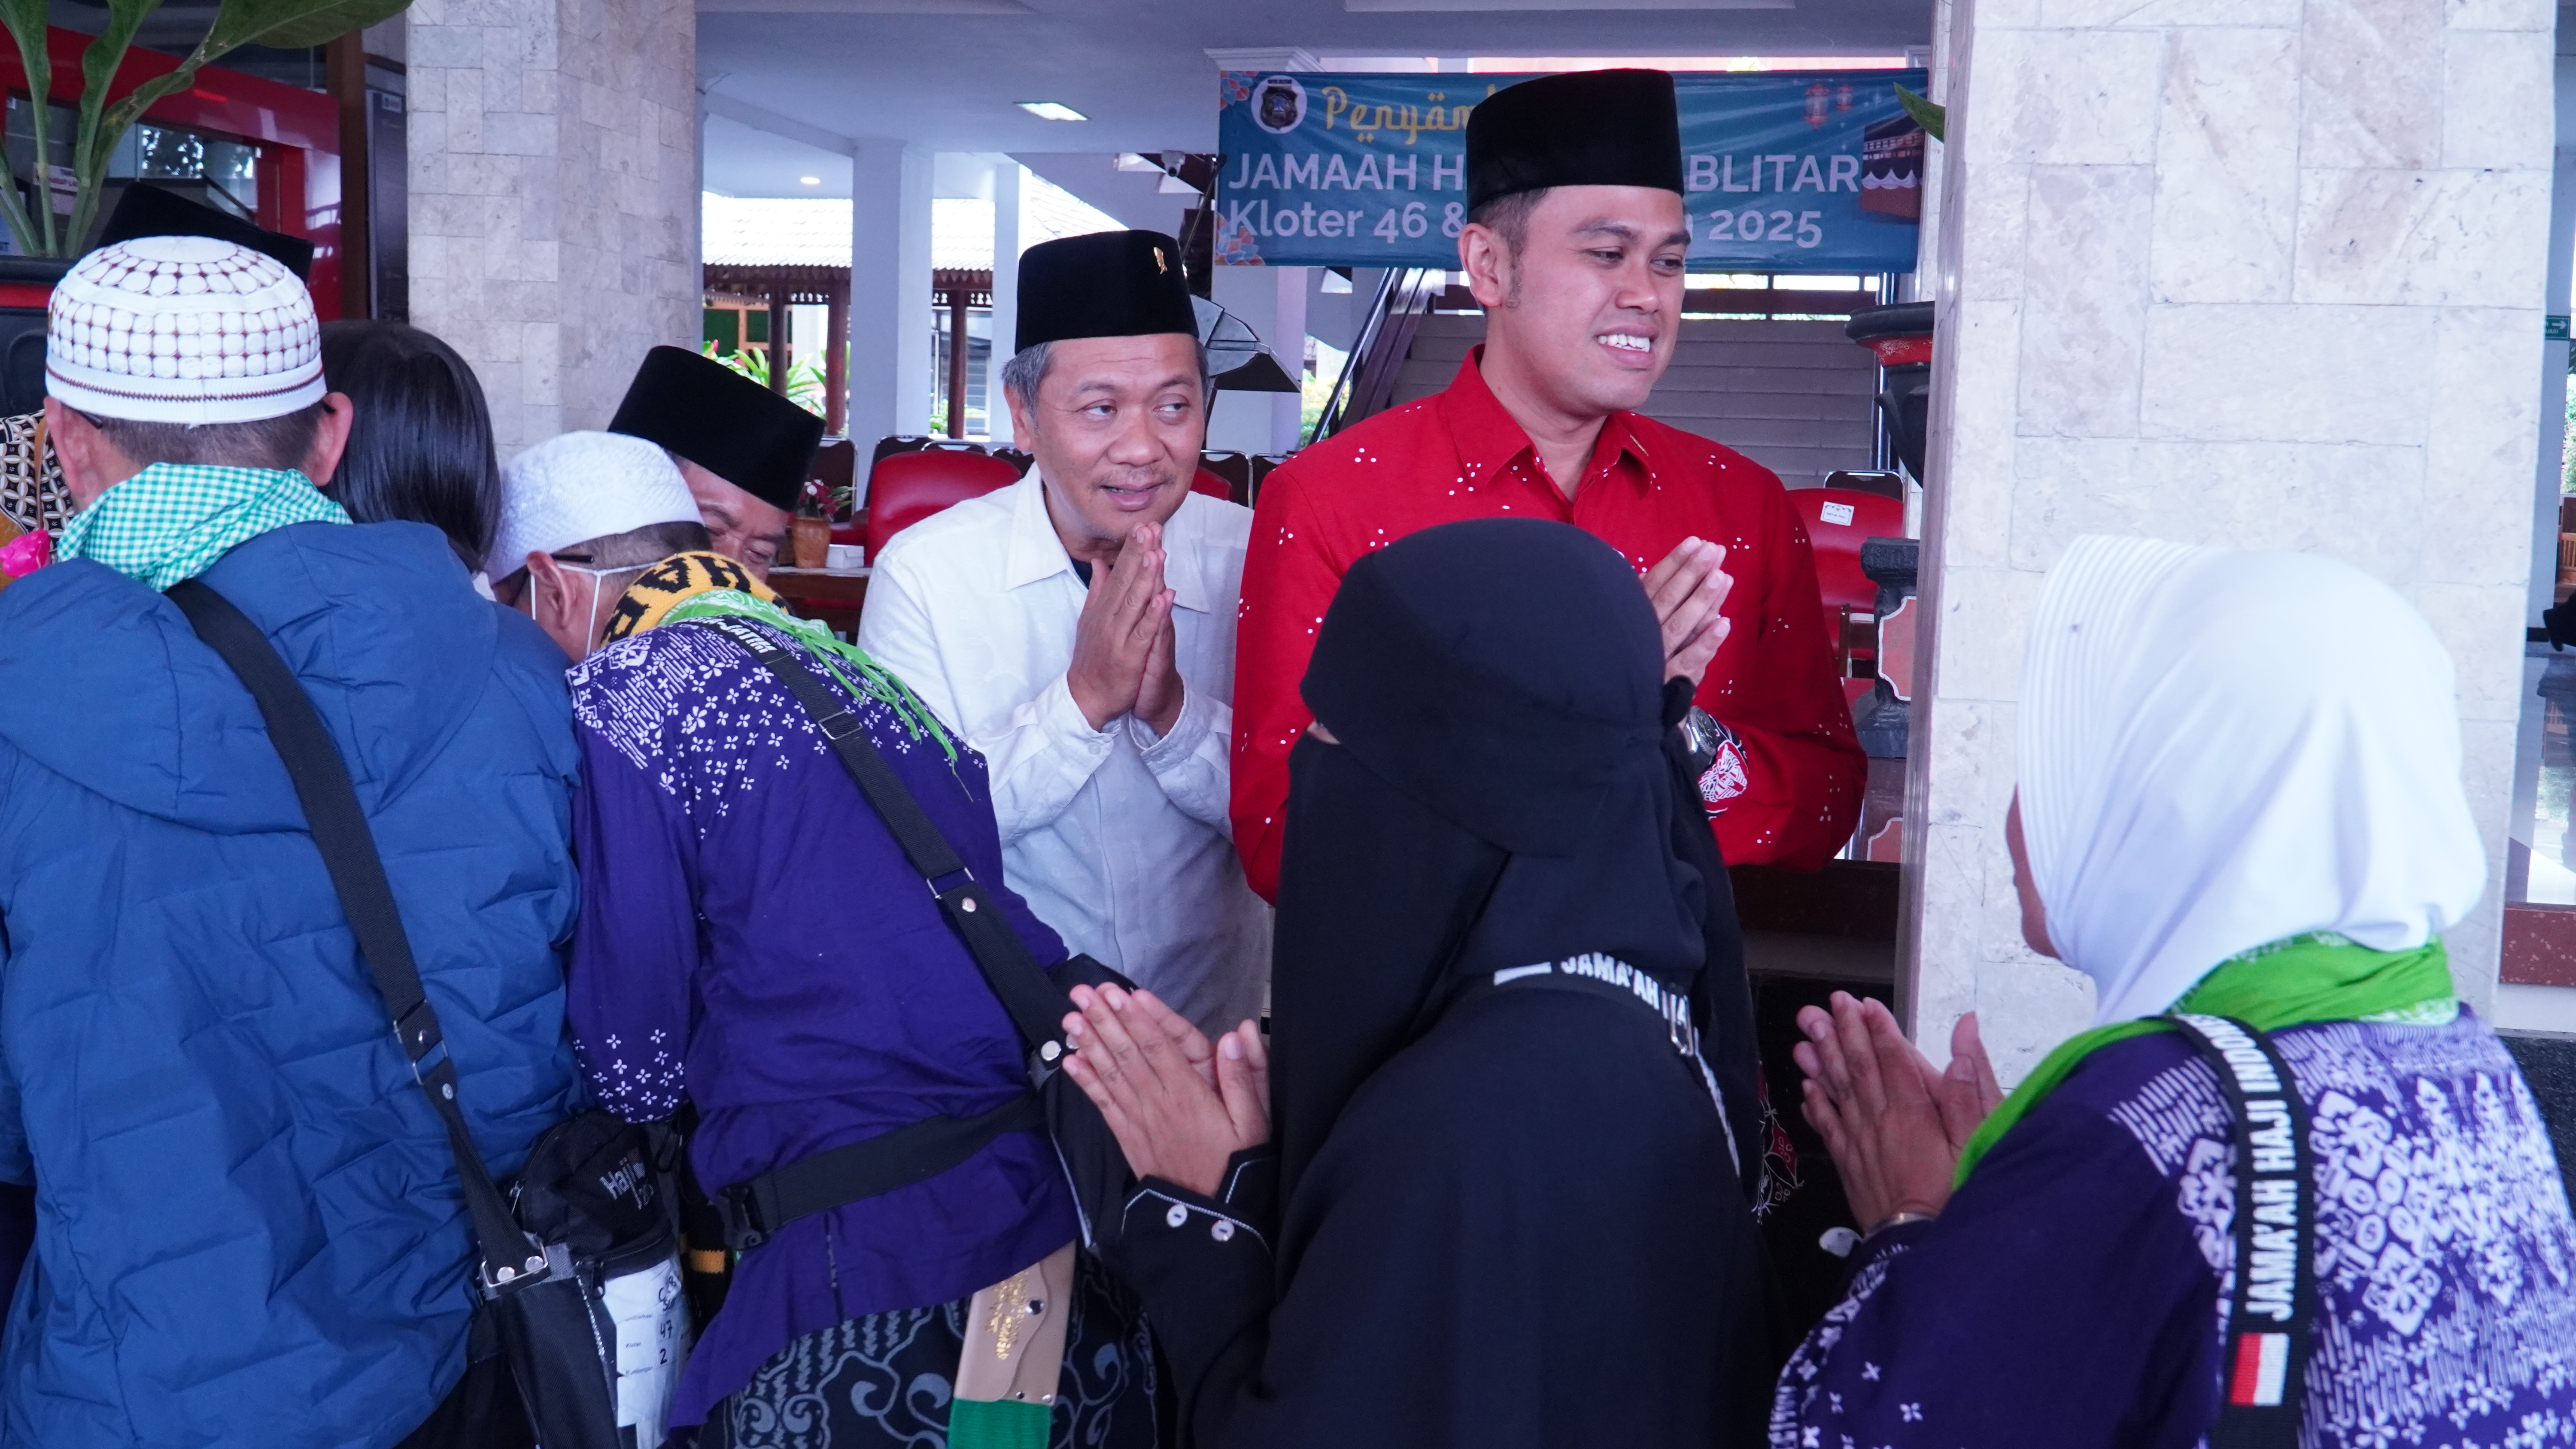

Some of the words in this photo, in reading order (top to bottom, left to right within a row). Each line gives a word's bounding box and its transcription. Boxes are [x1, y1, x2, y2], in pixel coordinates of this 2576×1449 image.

[1228, 153, 1417, 190] JAMAAH
[1688, 155, 1859, 192] BLITAR
[1230, 199, 1364, 237] Kloter
[1373, 201, 1428, 243] 46
[1442, 202, 1467, 238] &
[1708, 209, 1823, 249] 2025
[1560, 952, 1660, 1010] JAMA'AH
[2244, 1100, 2297, 1173] HAJI
[2245, 1179, 2298, 1322] JAMA'AH
[659, 1348, 667, 1365] 2
